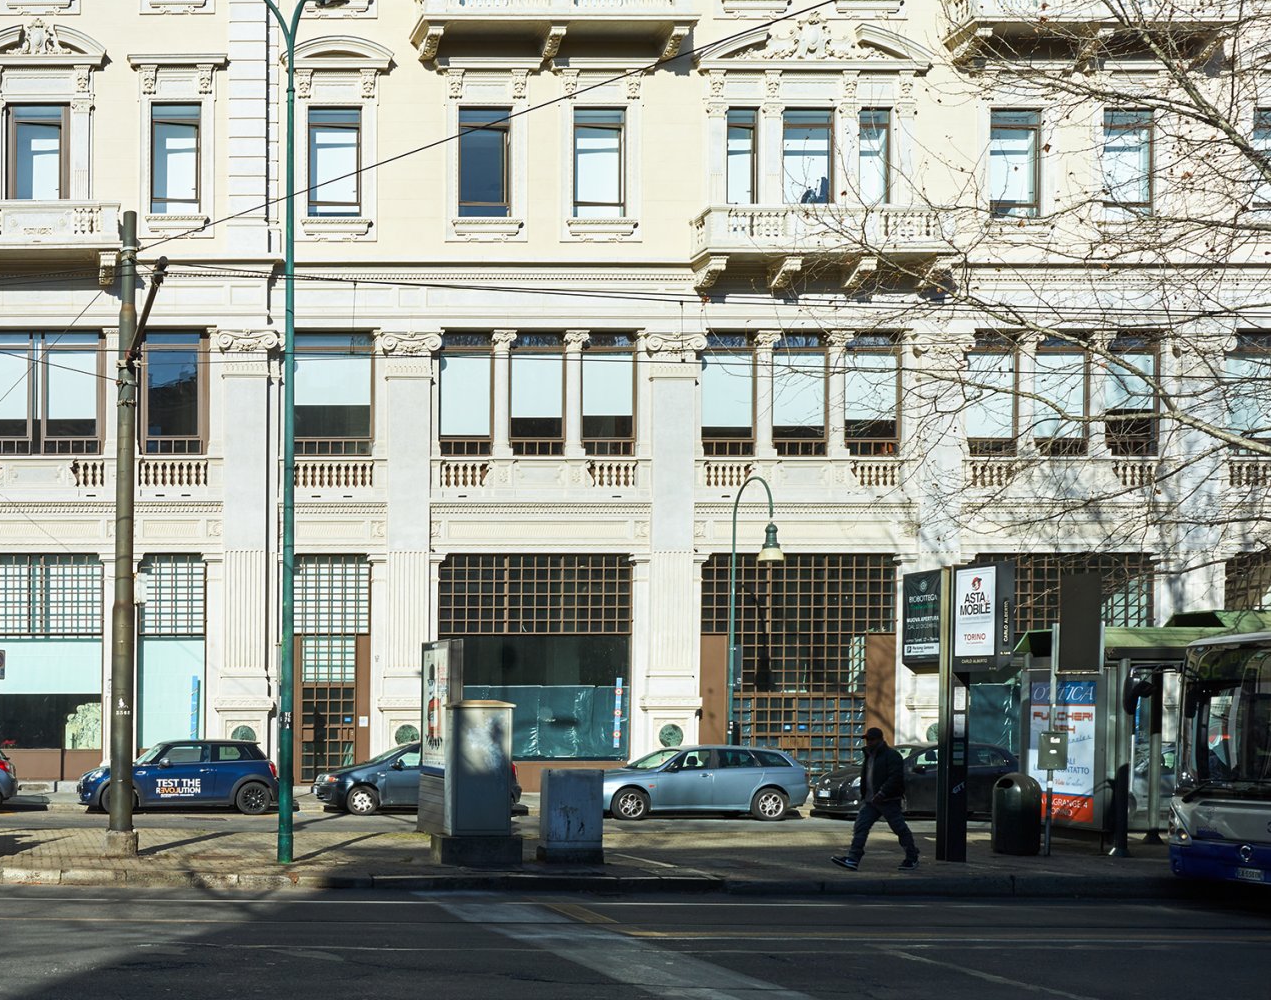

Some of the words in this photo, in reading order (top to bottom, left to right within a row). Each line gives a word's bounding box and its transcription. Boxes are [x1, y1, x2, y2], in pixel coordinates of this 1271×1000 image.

[964, 591, 985, 604] ASTA
[960, 602, 991, 616] MOBILE
[963, 633, 986, 641] TORINO
[1032, 711, 1093, 722] FUCHERI
[156, 778, 180, 787] TEST
[181, 778, 201, 787] THE
[1083, 800, 1088, 808] 4
[1051, 806, 1073, 817] ORINO
